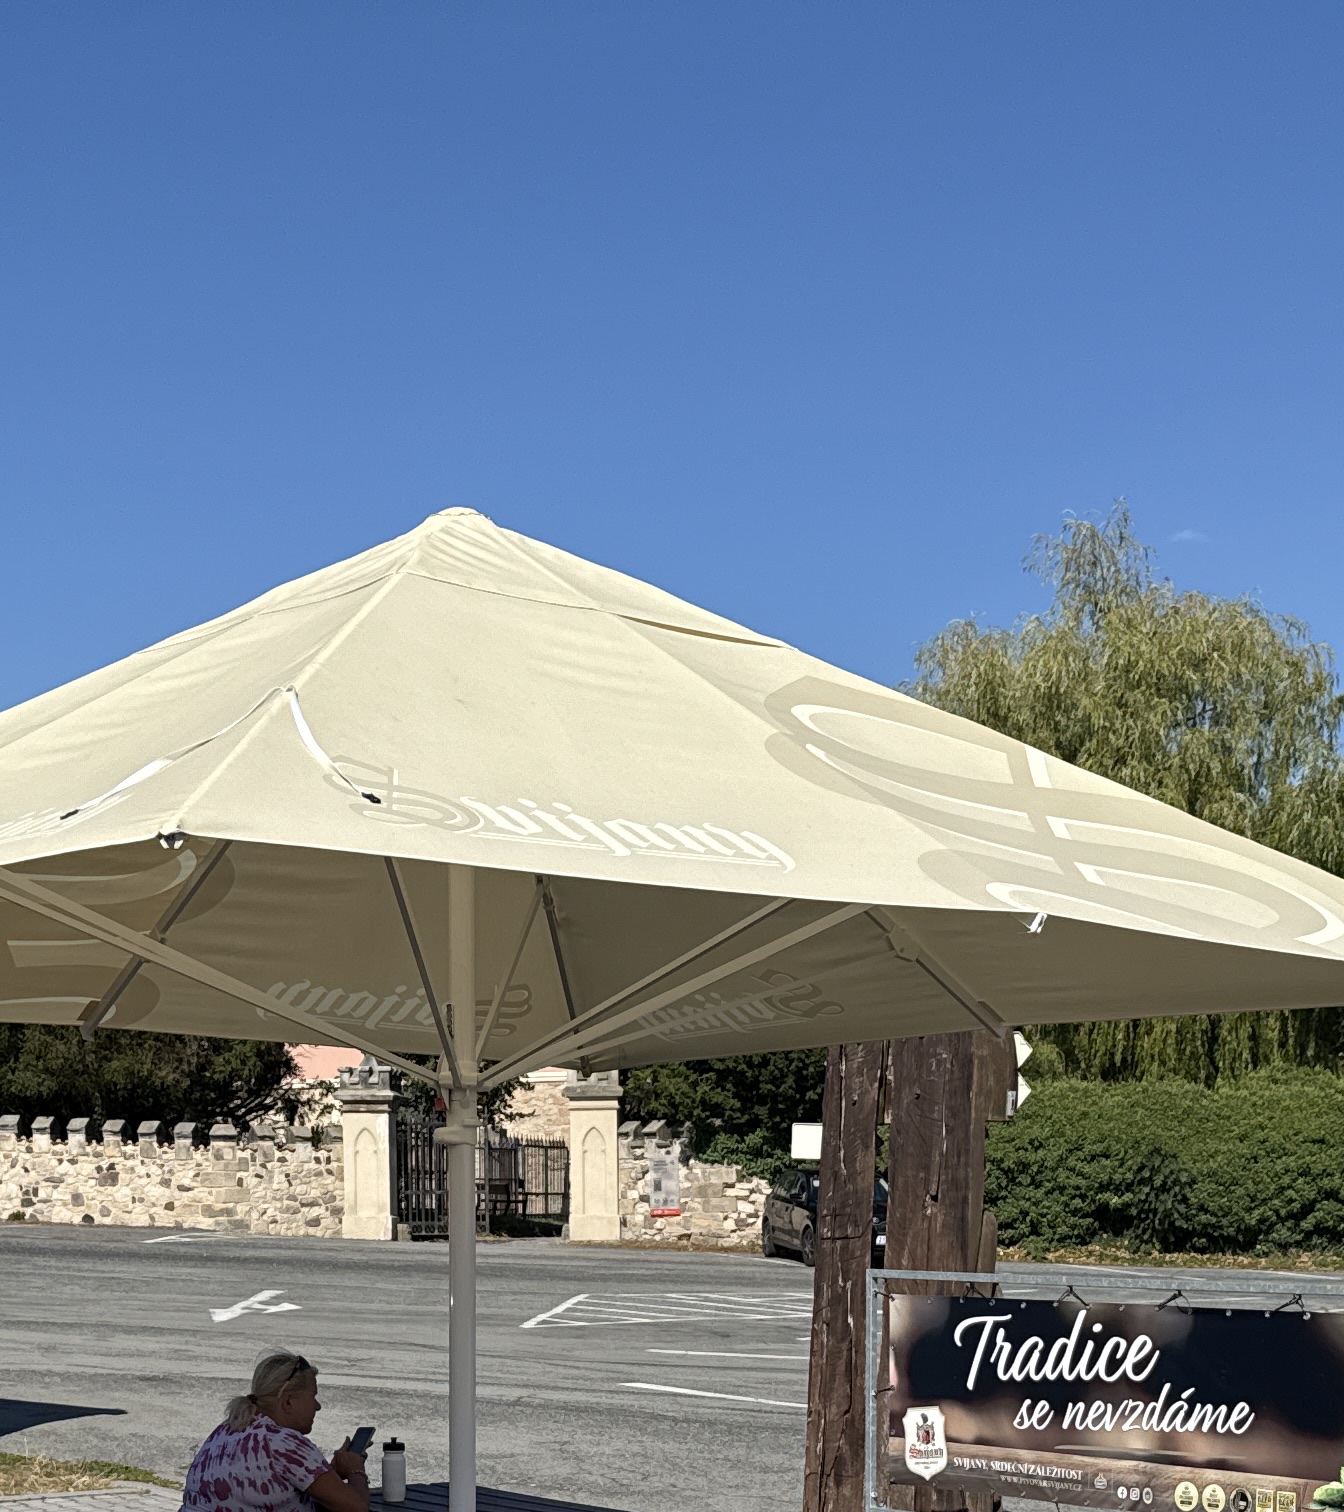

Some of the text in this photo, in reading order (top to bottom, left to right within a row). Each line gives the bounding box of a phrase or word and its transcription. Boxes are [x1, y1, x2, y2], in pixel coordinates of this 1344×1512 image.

[952, 1310, 1161, 1392] Tradice
[1013, 1386, 1255, 1436] se nevzdáme
[953, 1456, 988, 1471] SVIJANY,
[990, 1459, 1028, 1474] SRDEČNÍ
[1028, 1462, 1084, 1481] ZÁLEŽITOST
